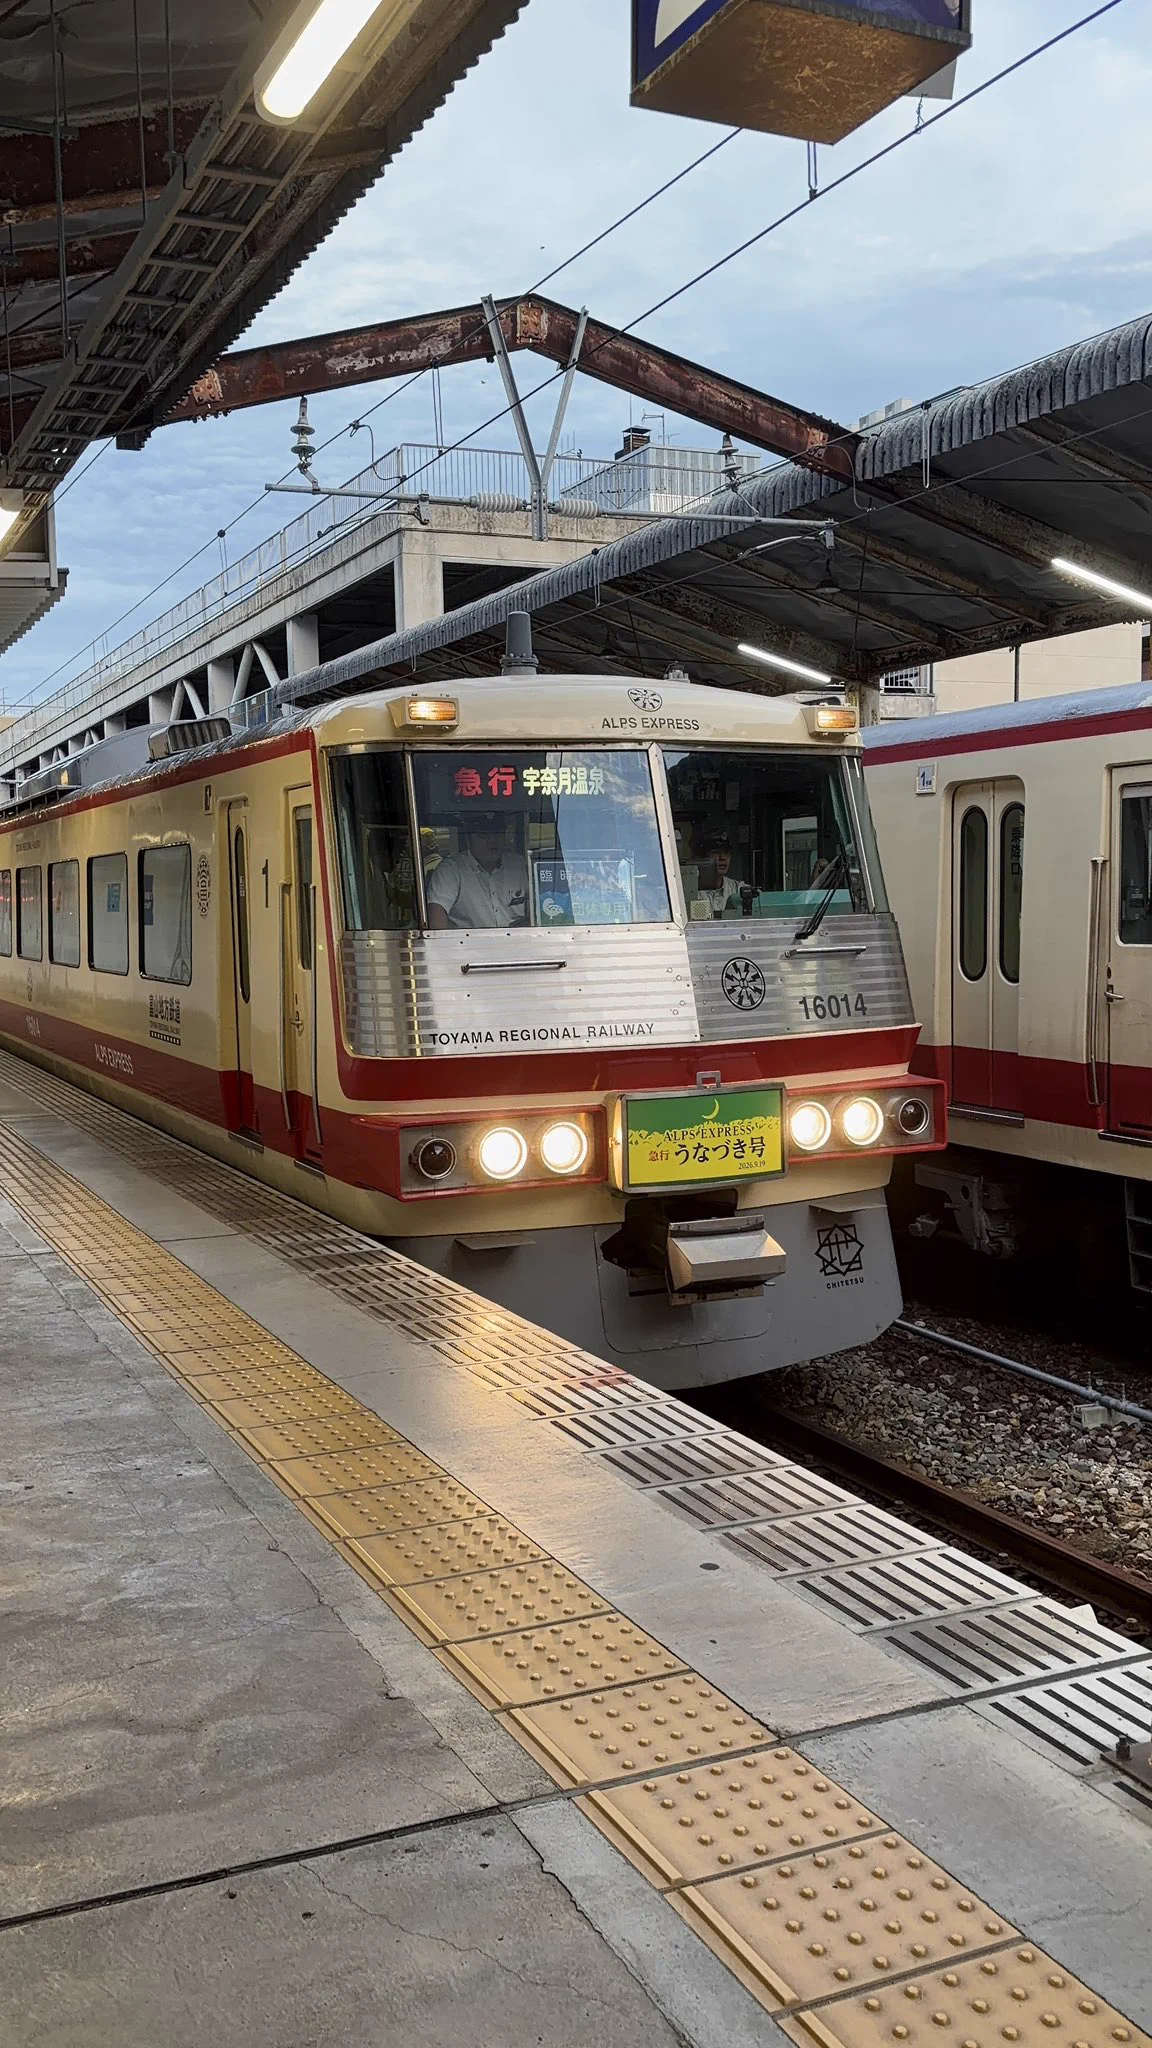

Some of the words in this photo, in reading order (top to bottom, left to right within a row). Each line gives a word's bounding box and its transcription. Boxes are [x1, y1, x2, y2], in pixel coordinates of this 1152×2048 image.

[601, 717, 638, 729] ALPS
[641, 717, 700, 730] EXPRESS
[454, 767, 516, 796] 急行
[522, 766, 605, 796] 宇奈月温泉
[261, 858, 269, 908] 1
[799, 993, 868, 1020] 16014
[429, 1031, 494, 1046] TOYAMA
[500, 1027, 581, 1042] REGIONAL
[587, 1023, 655, 1038] RAILWAY
[664, 1130, 696, 1142] ALPS
[701, 1124, 753, 1139] EXPRESS
[648, 1149, 670, 1162] 急行
[675, 1136, 766, 1166] うなづき号
[826, 1277, 865, 1290] CHITETSU
